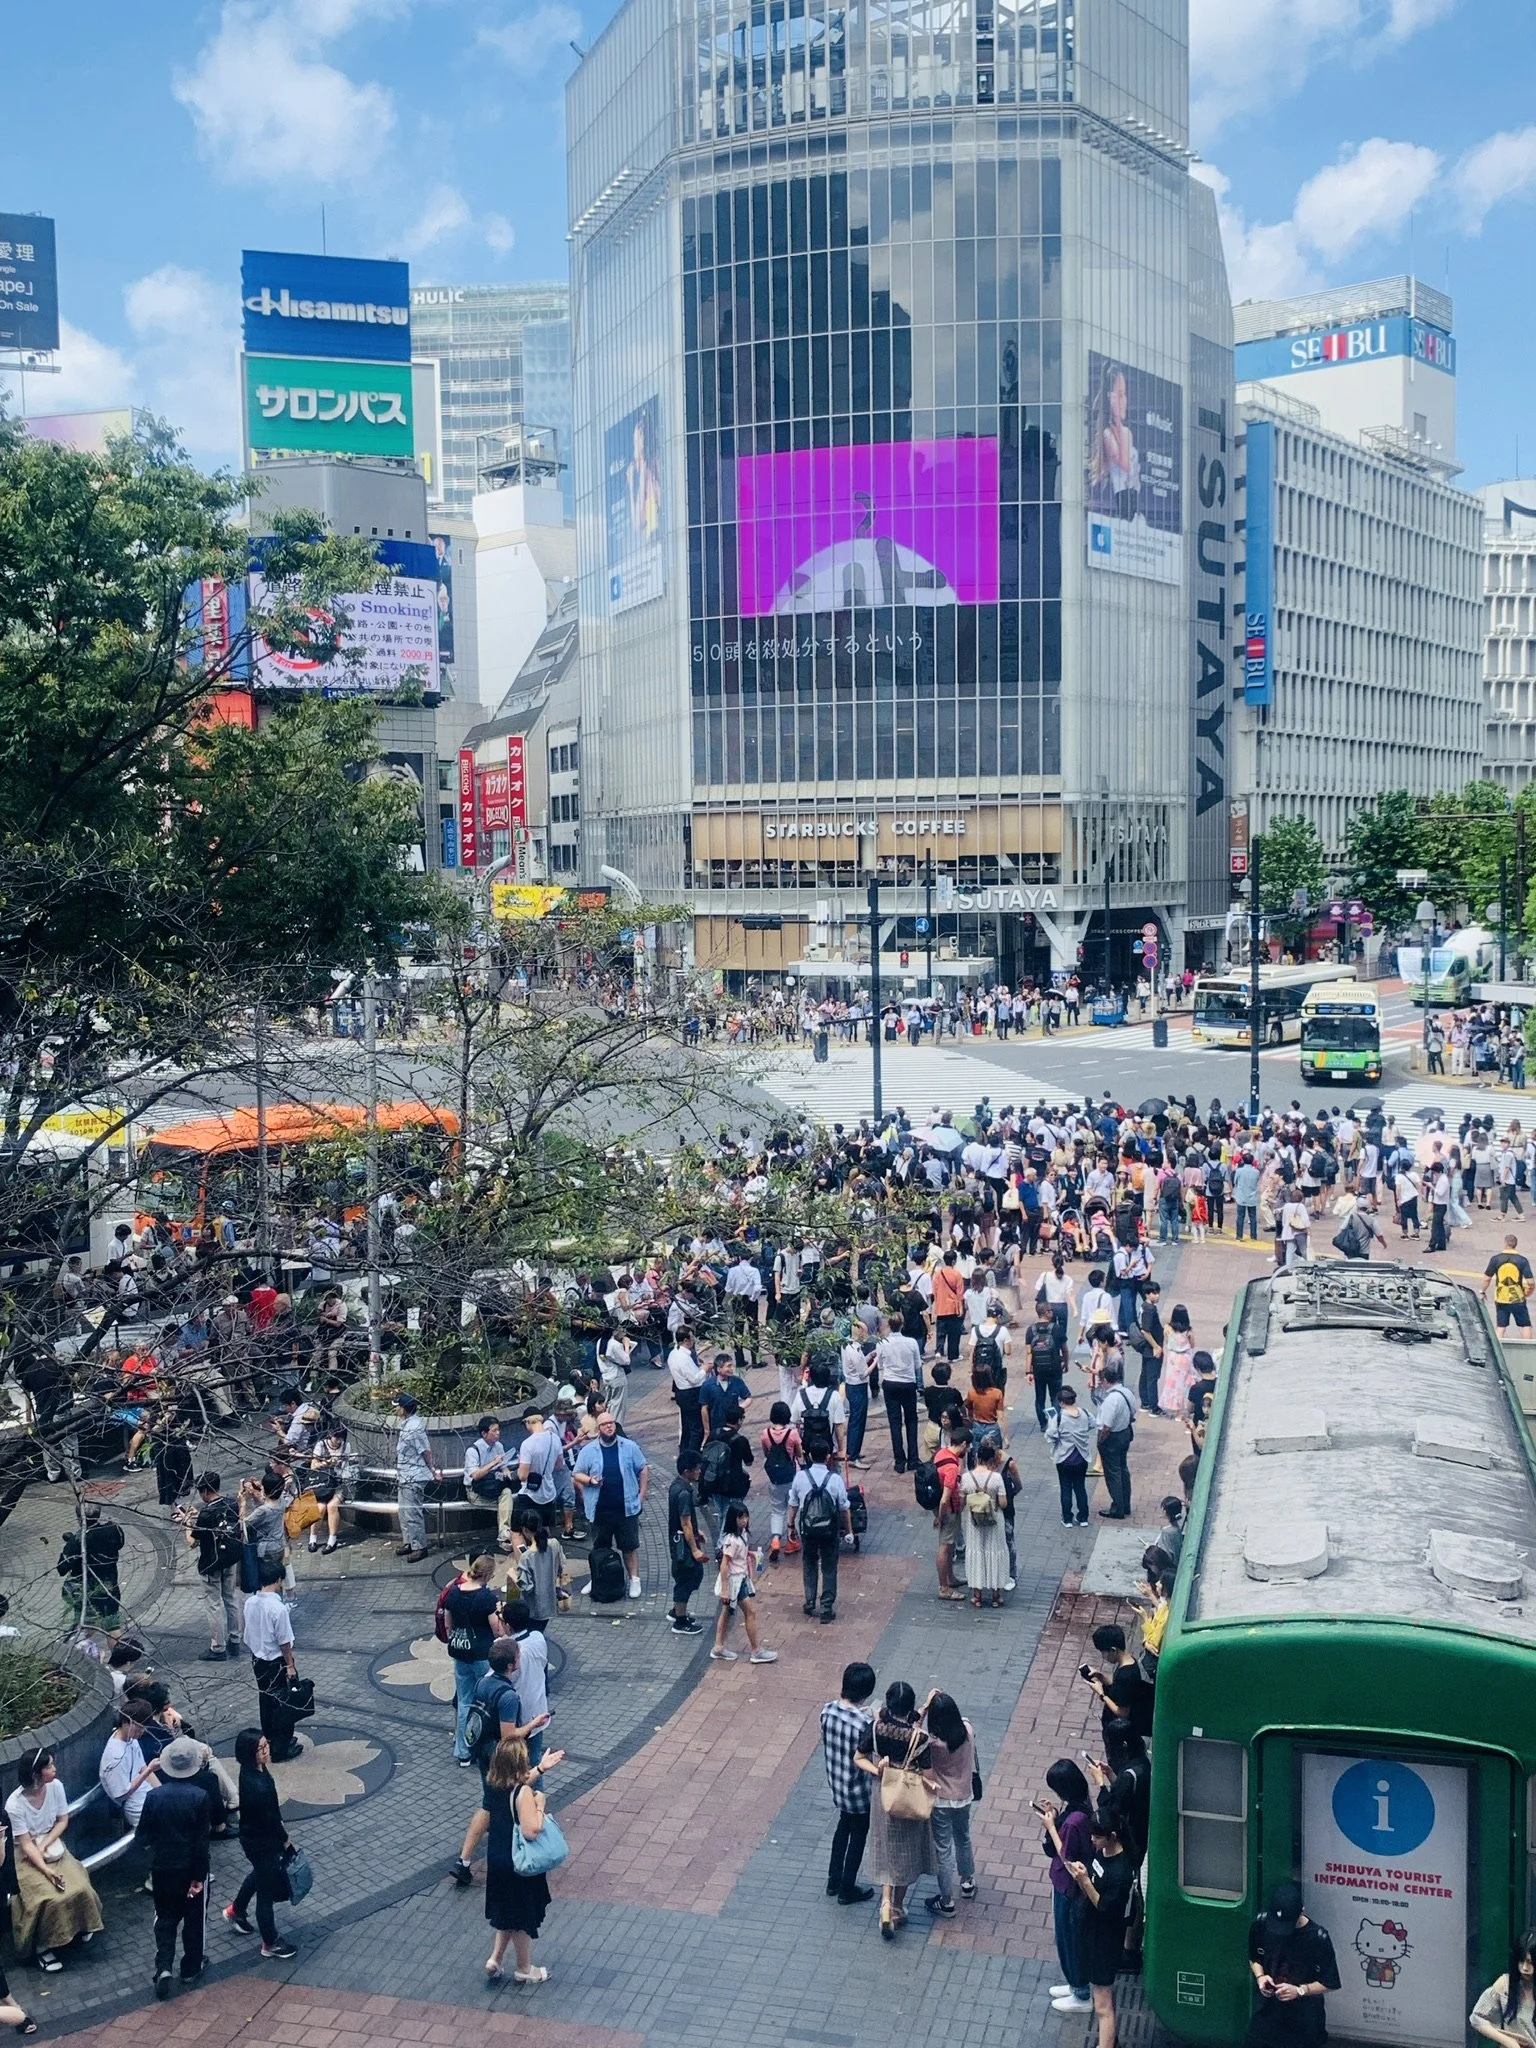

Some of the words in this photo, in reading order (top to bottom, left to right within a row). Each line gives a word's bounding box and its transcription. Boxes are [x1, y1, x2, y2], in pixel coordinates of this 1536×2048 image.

[16, 301, 39, 312] Sale
[244, 287, 409, 326] Hisamitsu
[413, 290, 465, 305] HULIC
[1290, 324, 1387, 369] SEIBU
[1413, 327, 1451, 370] SEIBU
[255, 384, 407, 426] サロンパス
[361, 599, 433, 620] Smoking!
[1196, 397, 1227, 817] TSUTAYA
[1245, 611, 1267, 690] SEIBU
[485, 773, 508, 796] カラオケ
[510, 745, 523, 809] カラオケ
[462, 802, 475, 859] カラオケ
[765, 820, 879, 839] STARBUCKS
[890, 819, 967, 836] COFFEE
[1314, 1873, 1399, 1892] INFOMATION
[1403, 1884, 1453, 1899] CENTER
[1325, 1862, 1382, 1877] SHIBUYA
[1386, 1869, 1442, 1884] TOURIST
